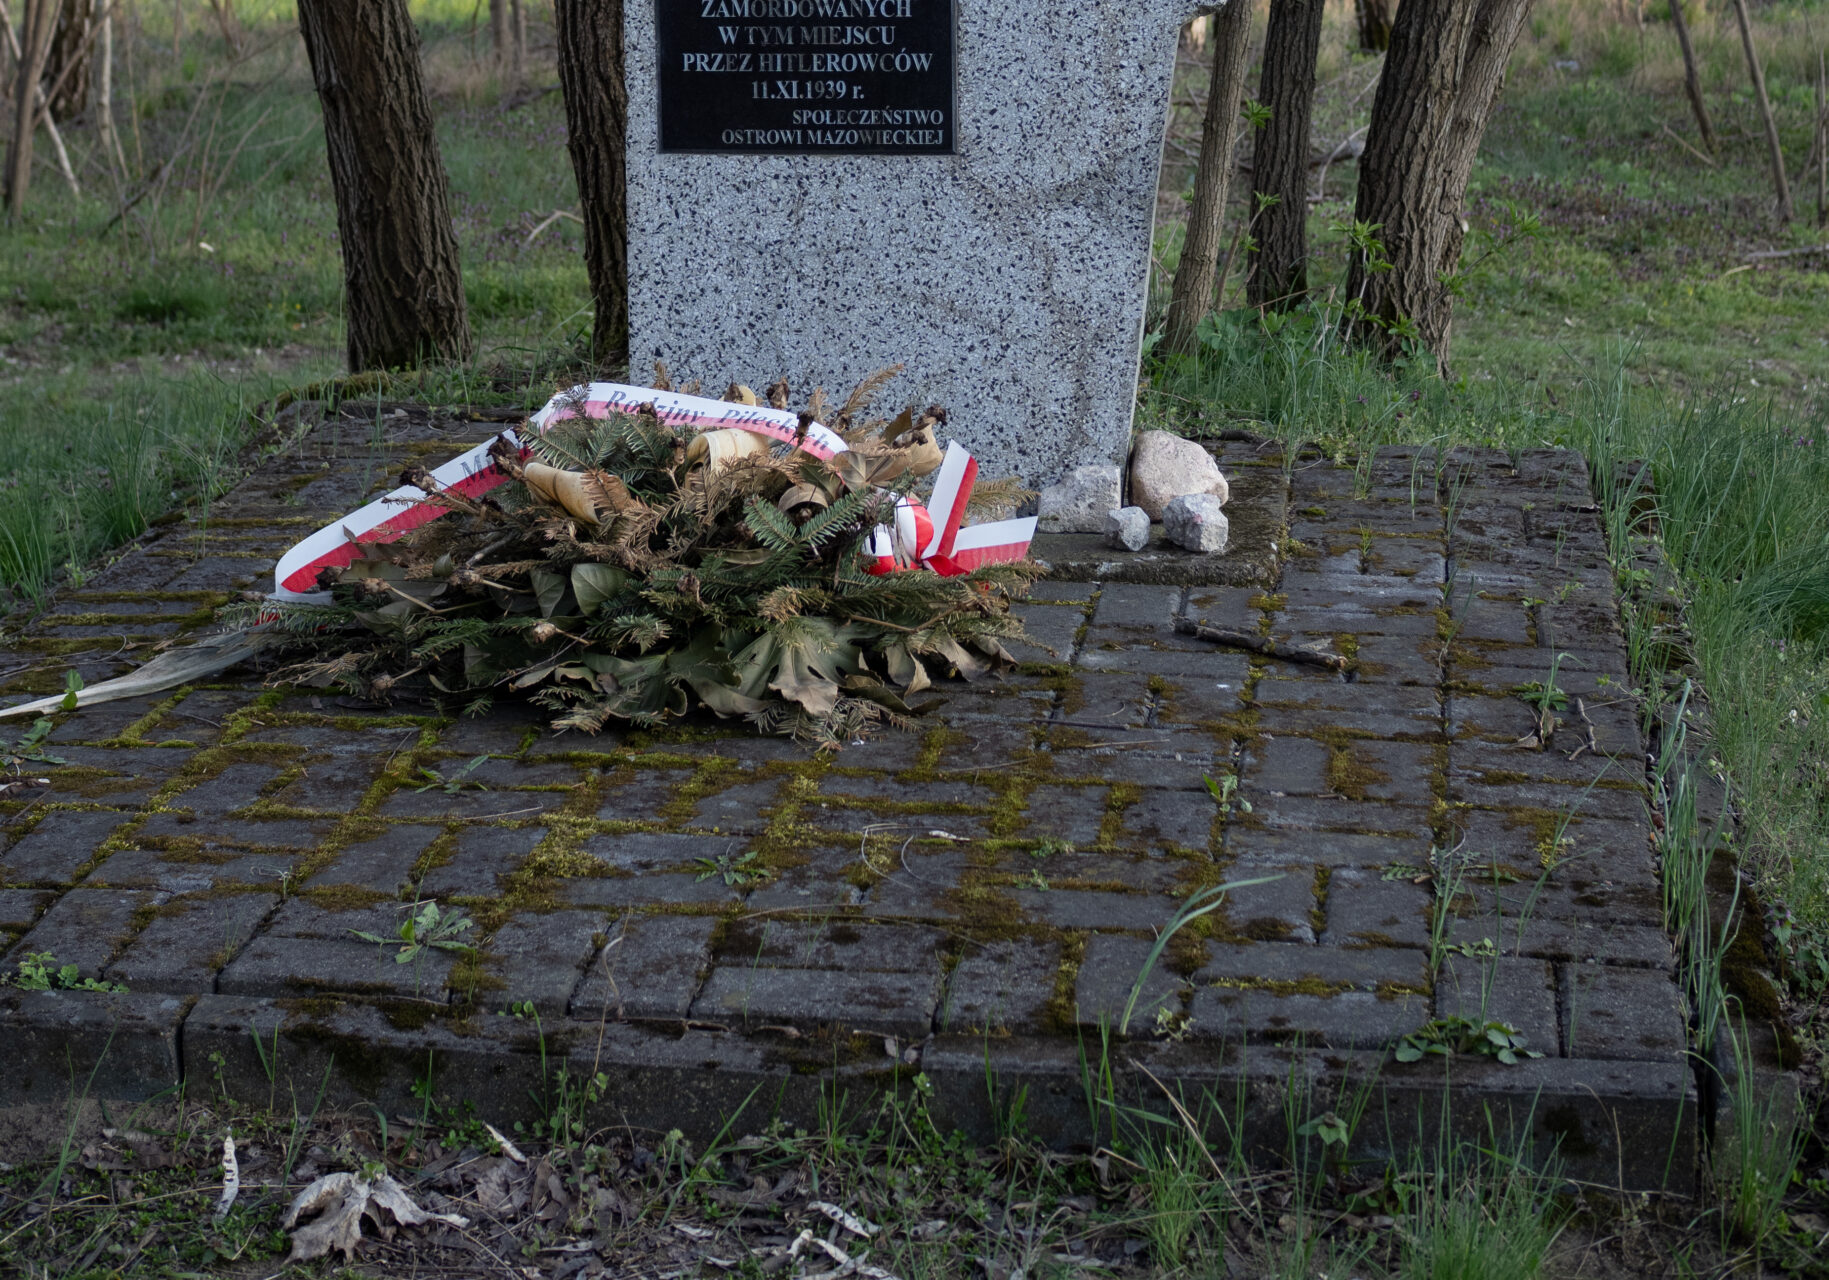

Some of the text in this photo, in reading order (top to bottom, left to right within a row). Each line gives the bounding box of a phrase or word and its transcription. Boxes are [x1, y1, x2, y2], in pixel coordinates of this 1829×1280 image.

[718, 26, 896, 45] W TYM MIEJSCU
[683, 48, 933, 72] PRZEZ HITLEROWCÓW
[751, 80, 865, 99] 11.XI.1939 r.
[793, 106, 944, 125] SPOŁECZEŃSTWO
[722, 129, 944, 145] OSTROWI MAZOWIECKIEJ
[718, 409, 828, 451] Pileckh
